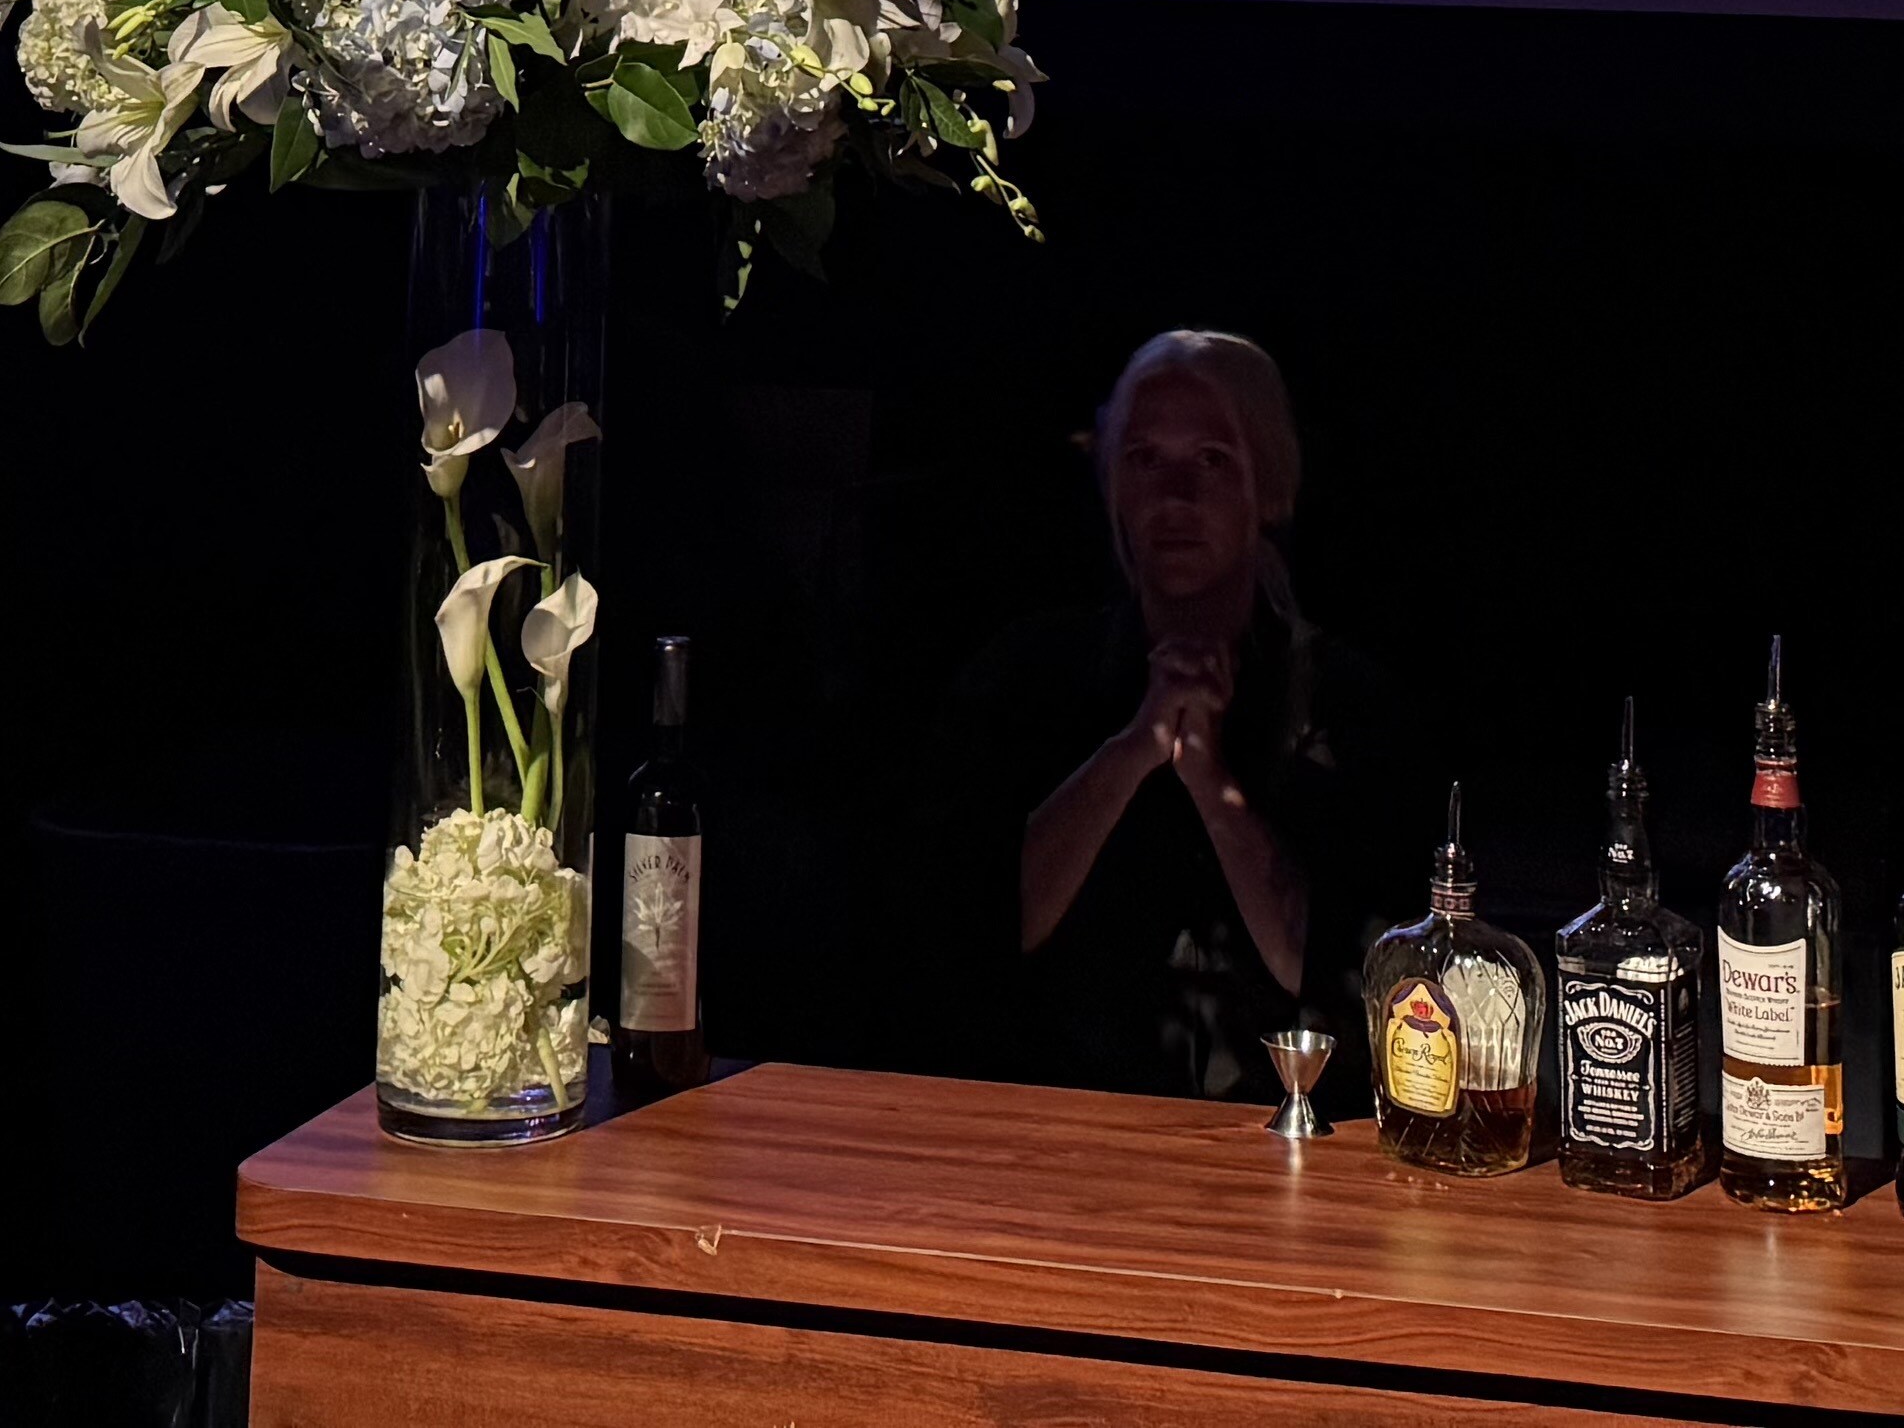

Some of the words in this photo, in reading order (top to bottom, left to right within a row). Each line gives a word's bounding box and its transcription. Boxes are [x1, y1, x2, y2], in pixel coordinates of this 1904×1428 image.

[1722, 958, 1798, 994] Dewar's
[1564, 996, 1600, 1026] JACK
[1599, 991, 1658, 1040] DANIEL'S
[1581, 1082, 1640, 1102] WHISKEY
